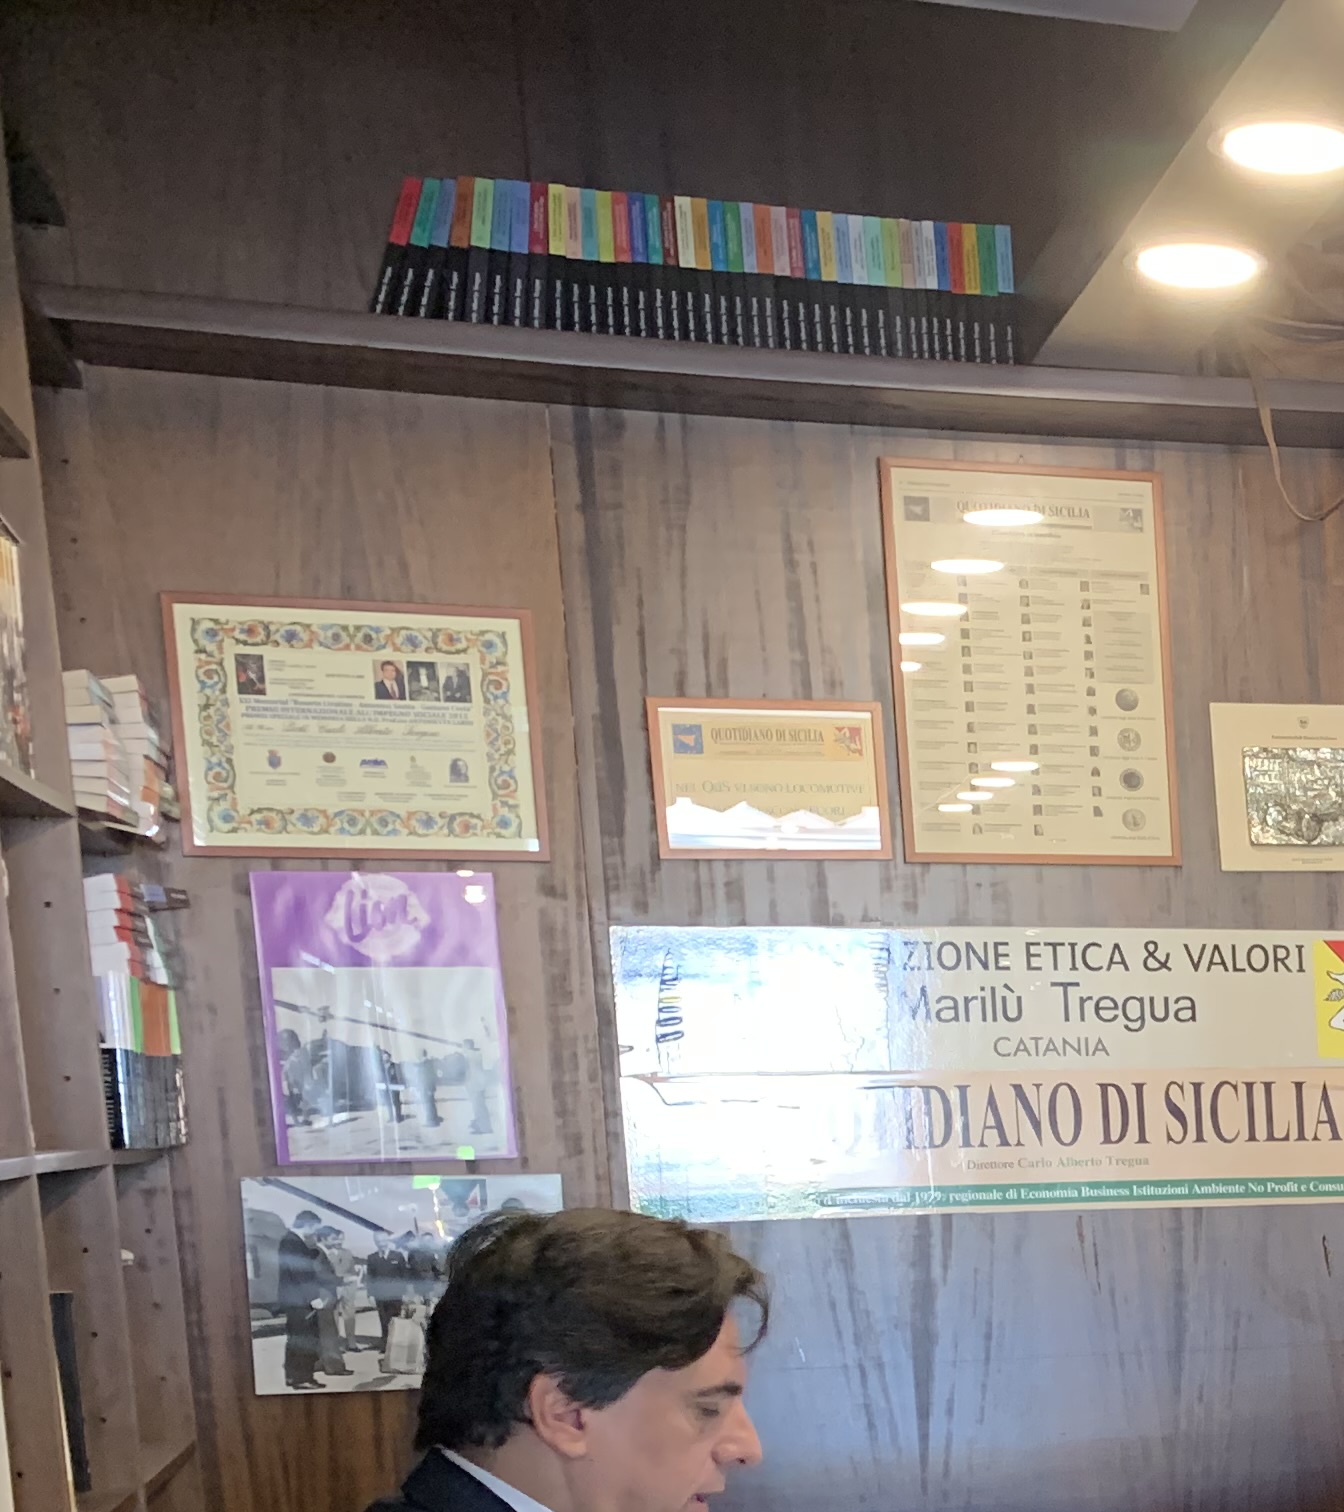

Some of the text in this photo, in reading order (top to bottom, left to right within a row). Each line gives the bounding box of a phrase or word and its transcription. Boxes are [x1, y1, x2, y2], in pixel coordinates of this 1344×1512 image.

[711, 727, 824, 743] QUOTIDIANO DI SICILIA
[903, 940, 1306, 974] ZIONE ETICA & VALORI
[903, 981, 1197, 1033] Marilù Tregua
[993, 1037, 1110, 1058] CATANIA
[1097, 1081, 1152, 1146] DI
[1164, 1080, 1343, 1145] SICILIA
[967, 1155, 1150, 1171] Direttore Carlo Alberto Tregua
[949, 1189, 1003, 1204] regionale
[1006, 1189, 1018, 1201] di
[1020, 1187, 1078, 1200] Economia
[1081, 1185, 1130, 1198] Business
[1133, 1184, 1189, 1197] Istituzioni
[1191, 1182, 1246, 1195] Ambiente
[1248, 1181, 1265, 1194] No
[1267, 1180, 1298, 1193] Profit
